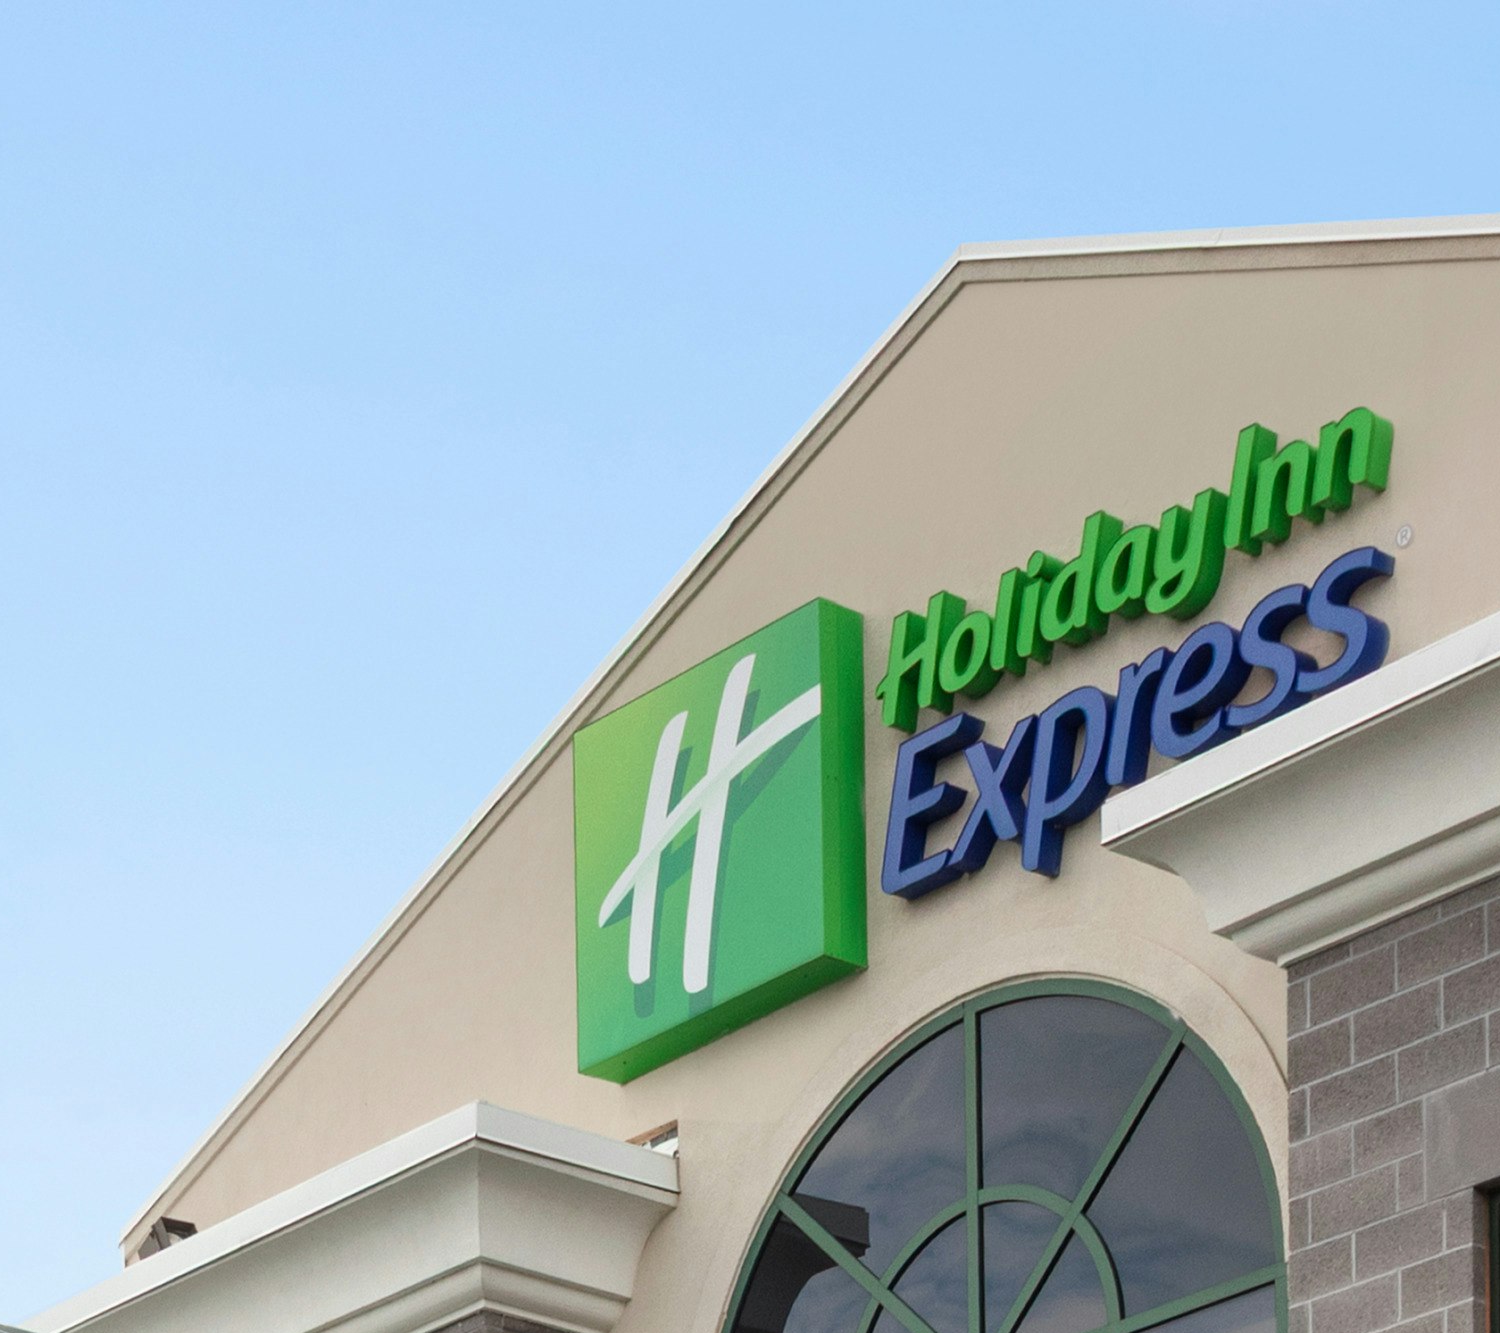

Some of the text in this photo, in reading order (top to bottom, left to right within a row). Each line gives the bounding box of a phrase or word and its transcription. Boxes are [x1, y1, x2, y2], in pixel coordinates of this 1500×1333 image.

[875, 405, 1394, 732] Holiday Inn
[881, 545, 1396, 901] Express
